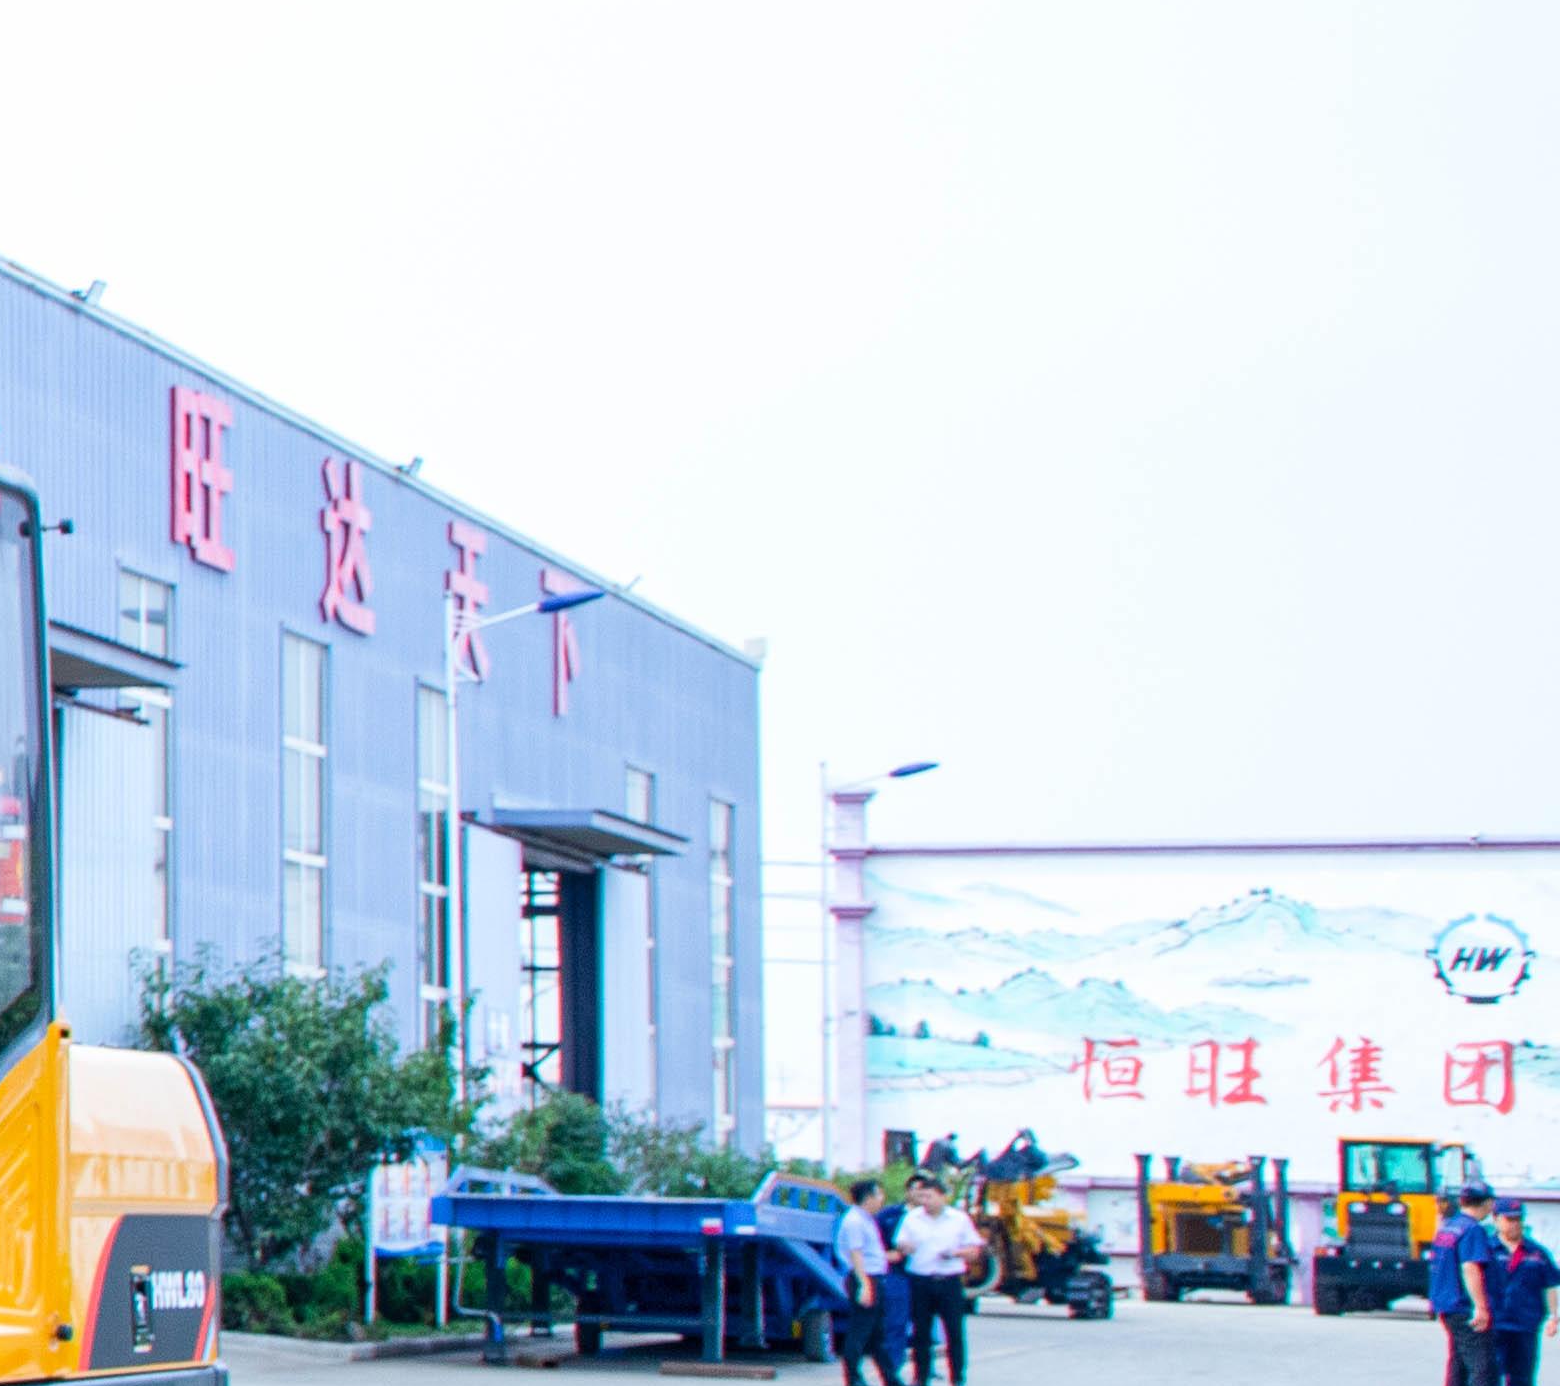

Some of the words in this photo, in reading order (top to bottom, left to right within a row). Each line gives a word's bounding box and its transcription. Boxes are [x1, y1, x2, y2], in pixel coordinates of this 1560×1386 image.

[1448, 947, 1513, 972] HW
[1068, 1036, 1516, 1114] 恒旺集团
